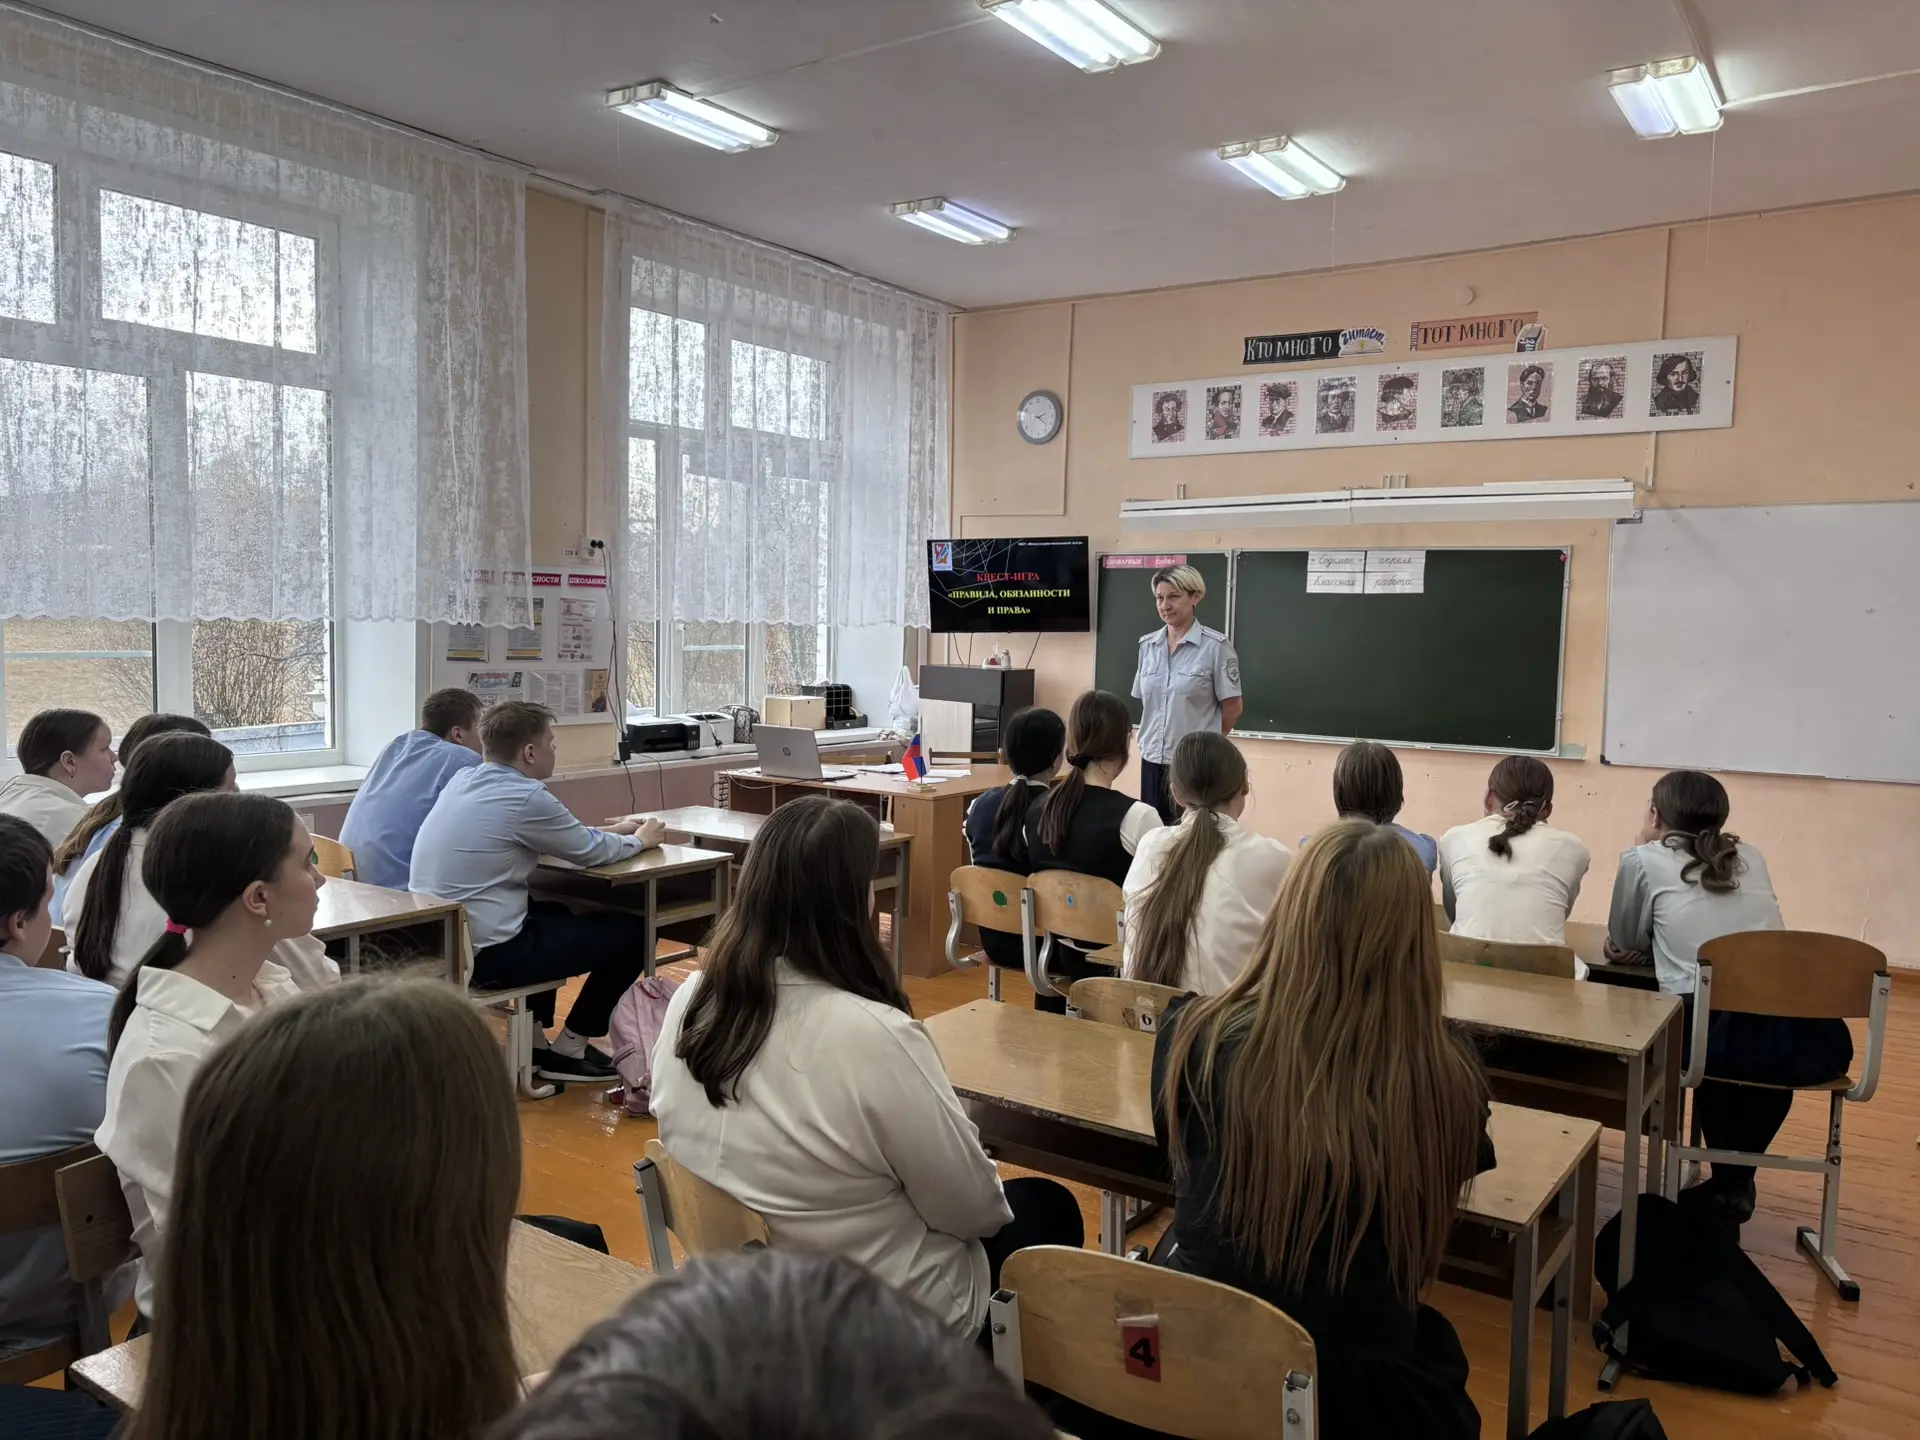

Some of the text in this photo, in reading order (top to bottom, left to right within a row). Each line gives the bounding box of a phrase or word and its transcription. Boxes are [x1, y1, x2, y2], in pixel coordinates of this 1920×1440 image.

[1420, 325, 1455, 345] ТОТ
[1460, 319, 1523, 342] МНОГО
[569, 577, 606, 585] ШКОЛЬНИК
[976, 572, 1041, 583] КВЕСТ-ИГРА
[1372, 574, 1412, 590] работа
[948, 588, 1071, 600] «ПРАВИЛА, ОБЯЗАННОСТИ
[988, 605, 1031, 615] И ПРАВА»
[1142, 1013, 1152, 1026] 6
[1128, 1336, 1156, 1368] 4
